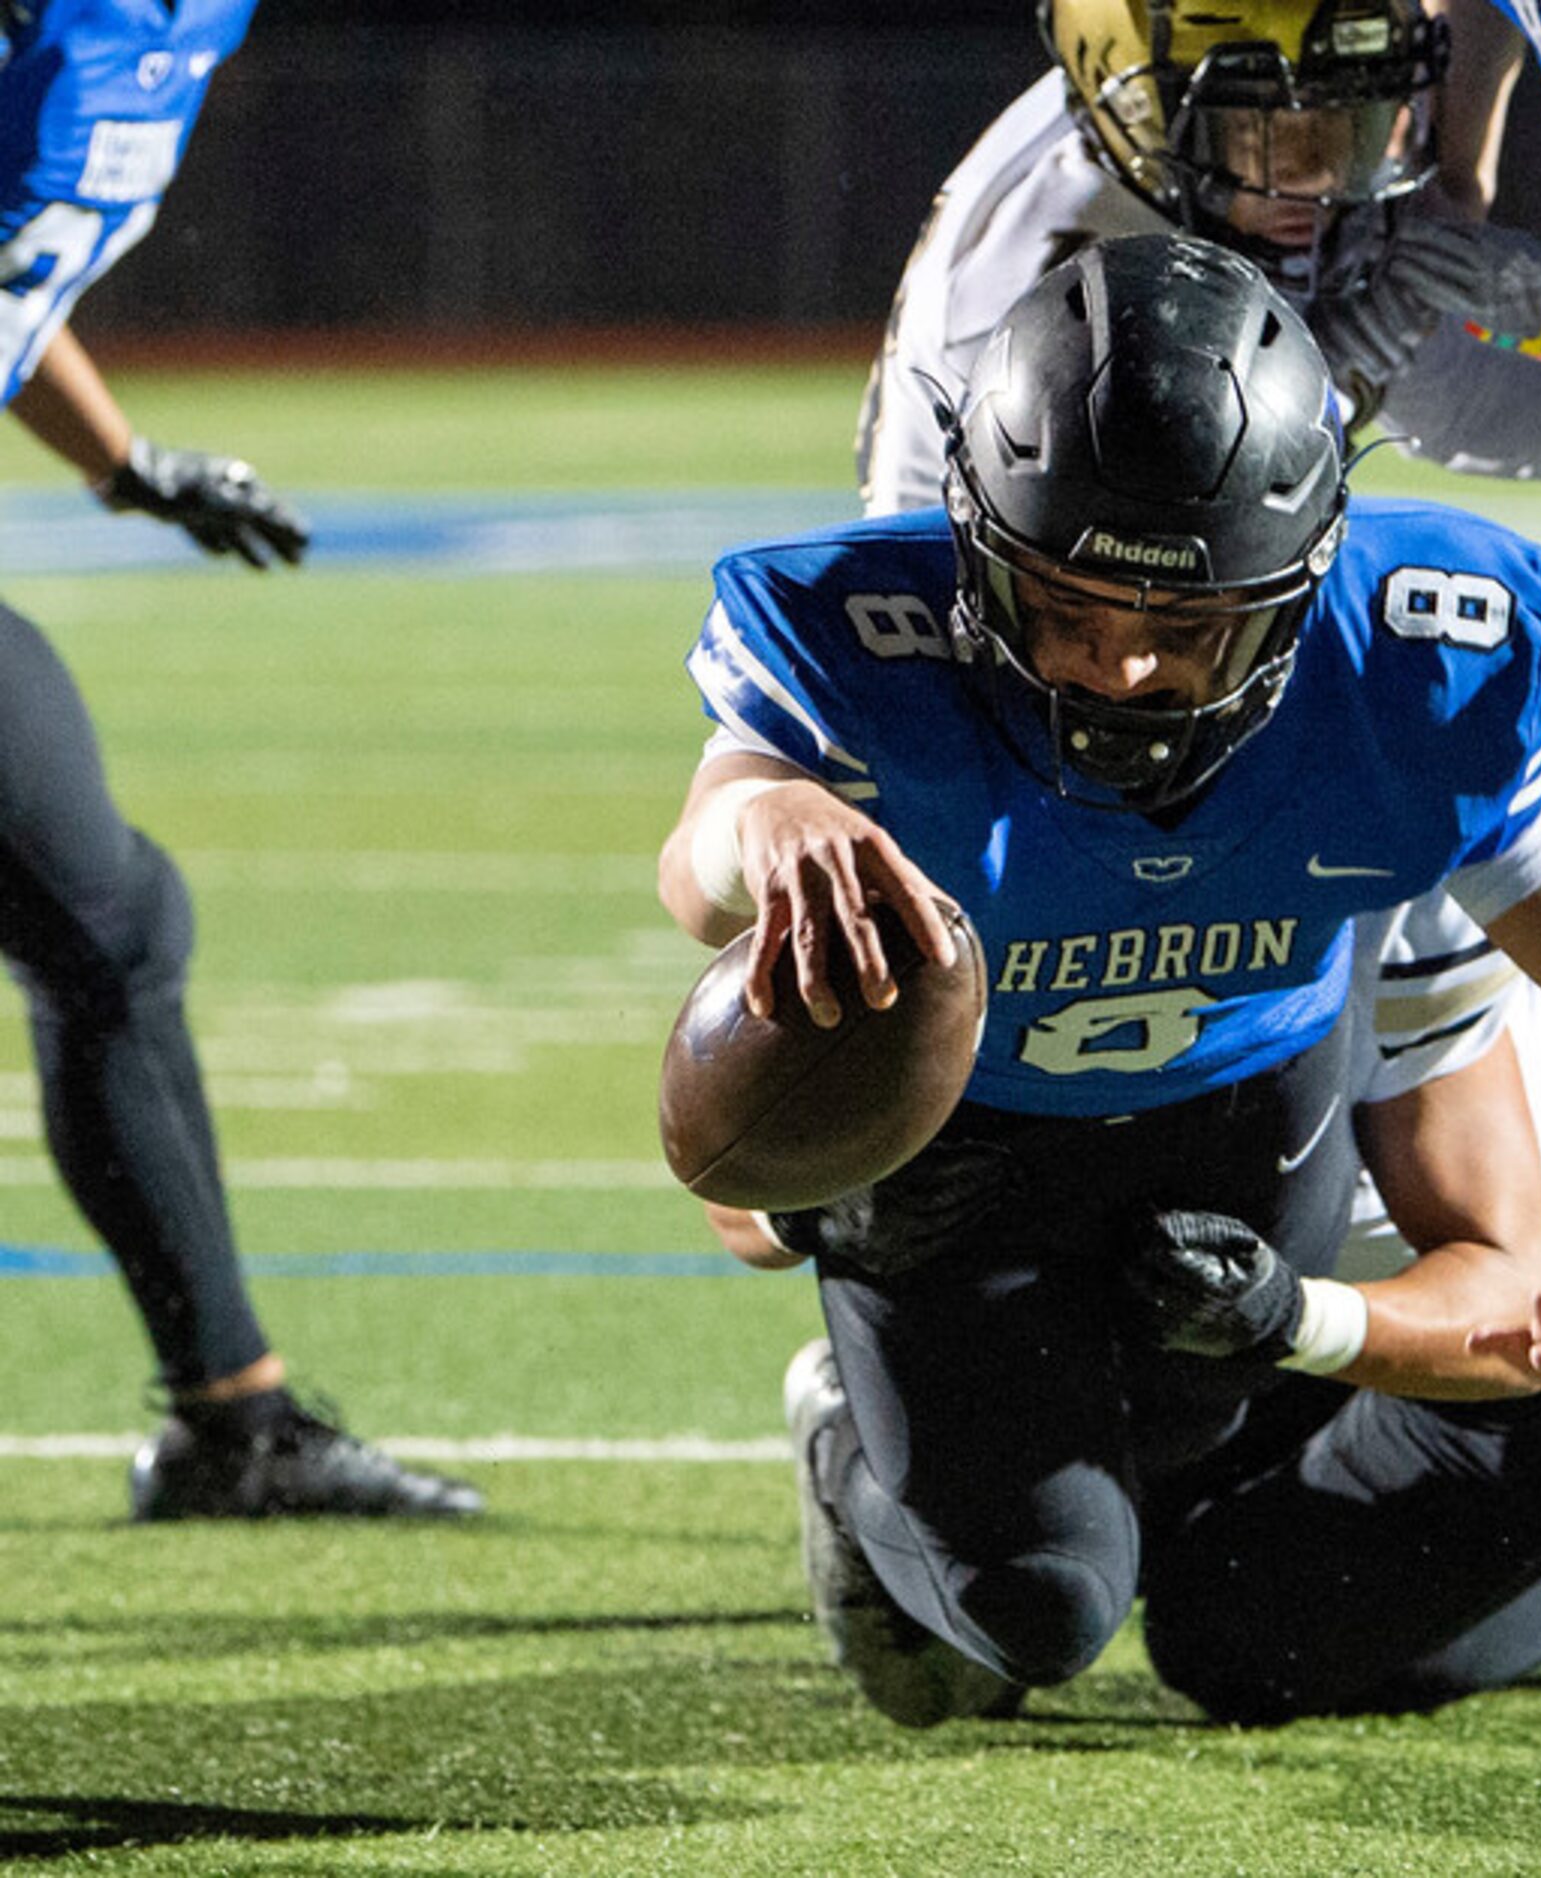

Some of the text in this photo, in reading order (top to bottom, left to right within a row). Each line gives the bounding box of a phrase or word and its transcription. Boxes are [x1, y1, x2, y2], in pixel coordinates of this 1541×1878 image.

[1093, 532, 1197, 569] Riddell
[845, 594, 953, 659] 8
[1383, 566, 1513, 650] 8
[996, 918, 1299, 993] HEBRON
